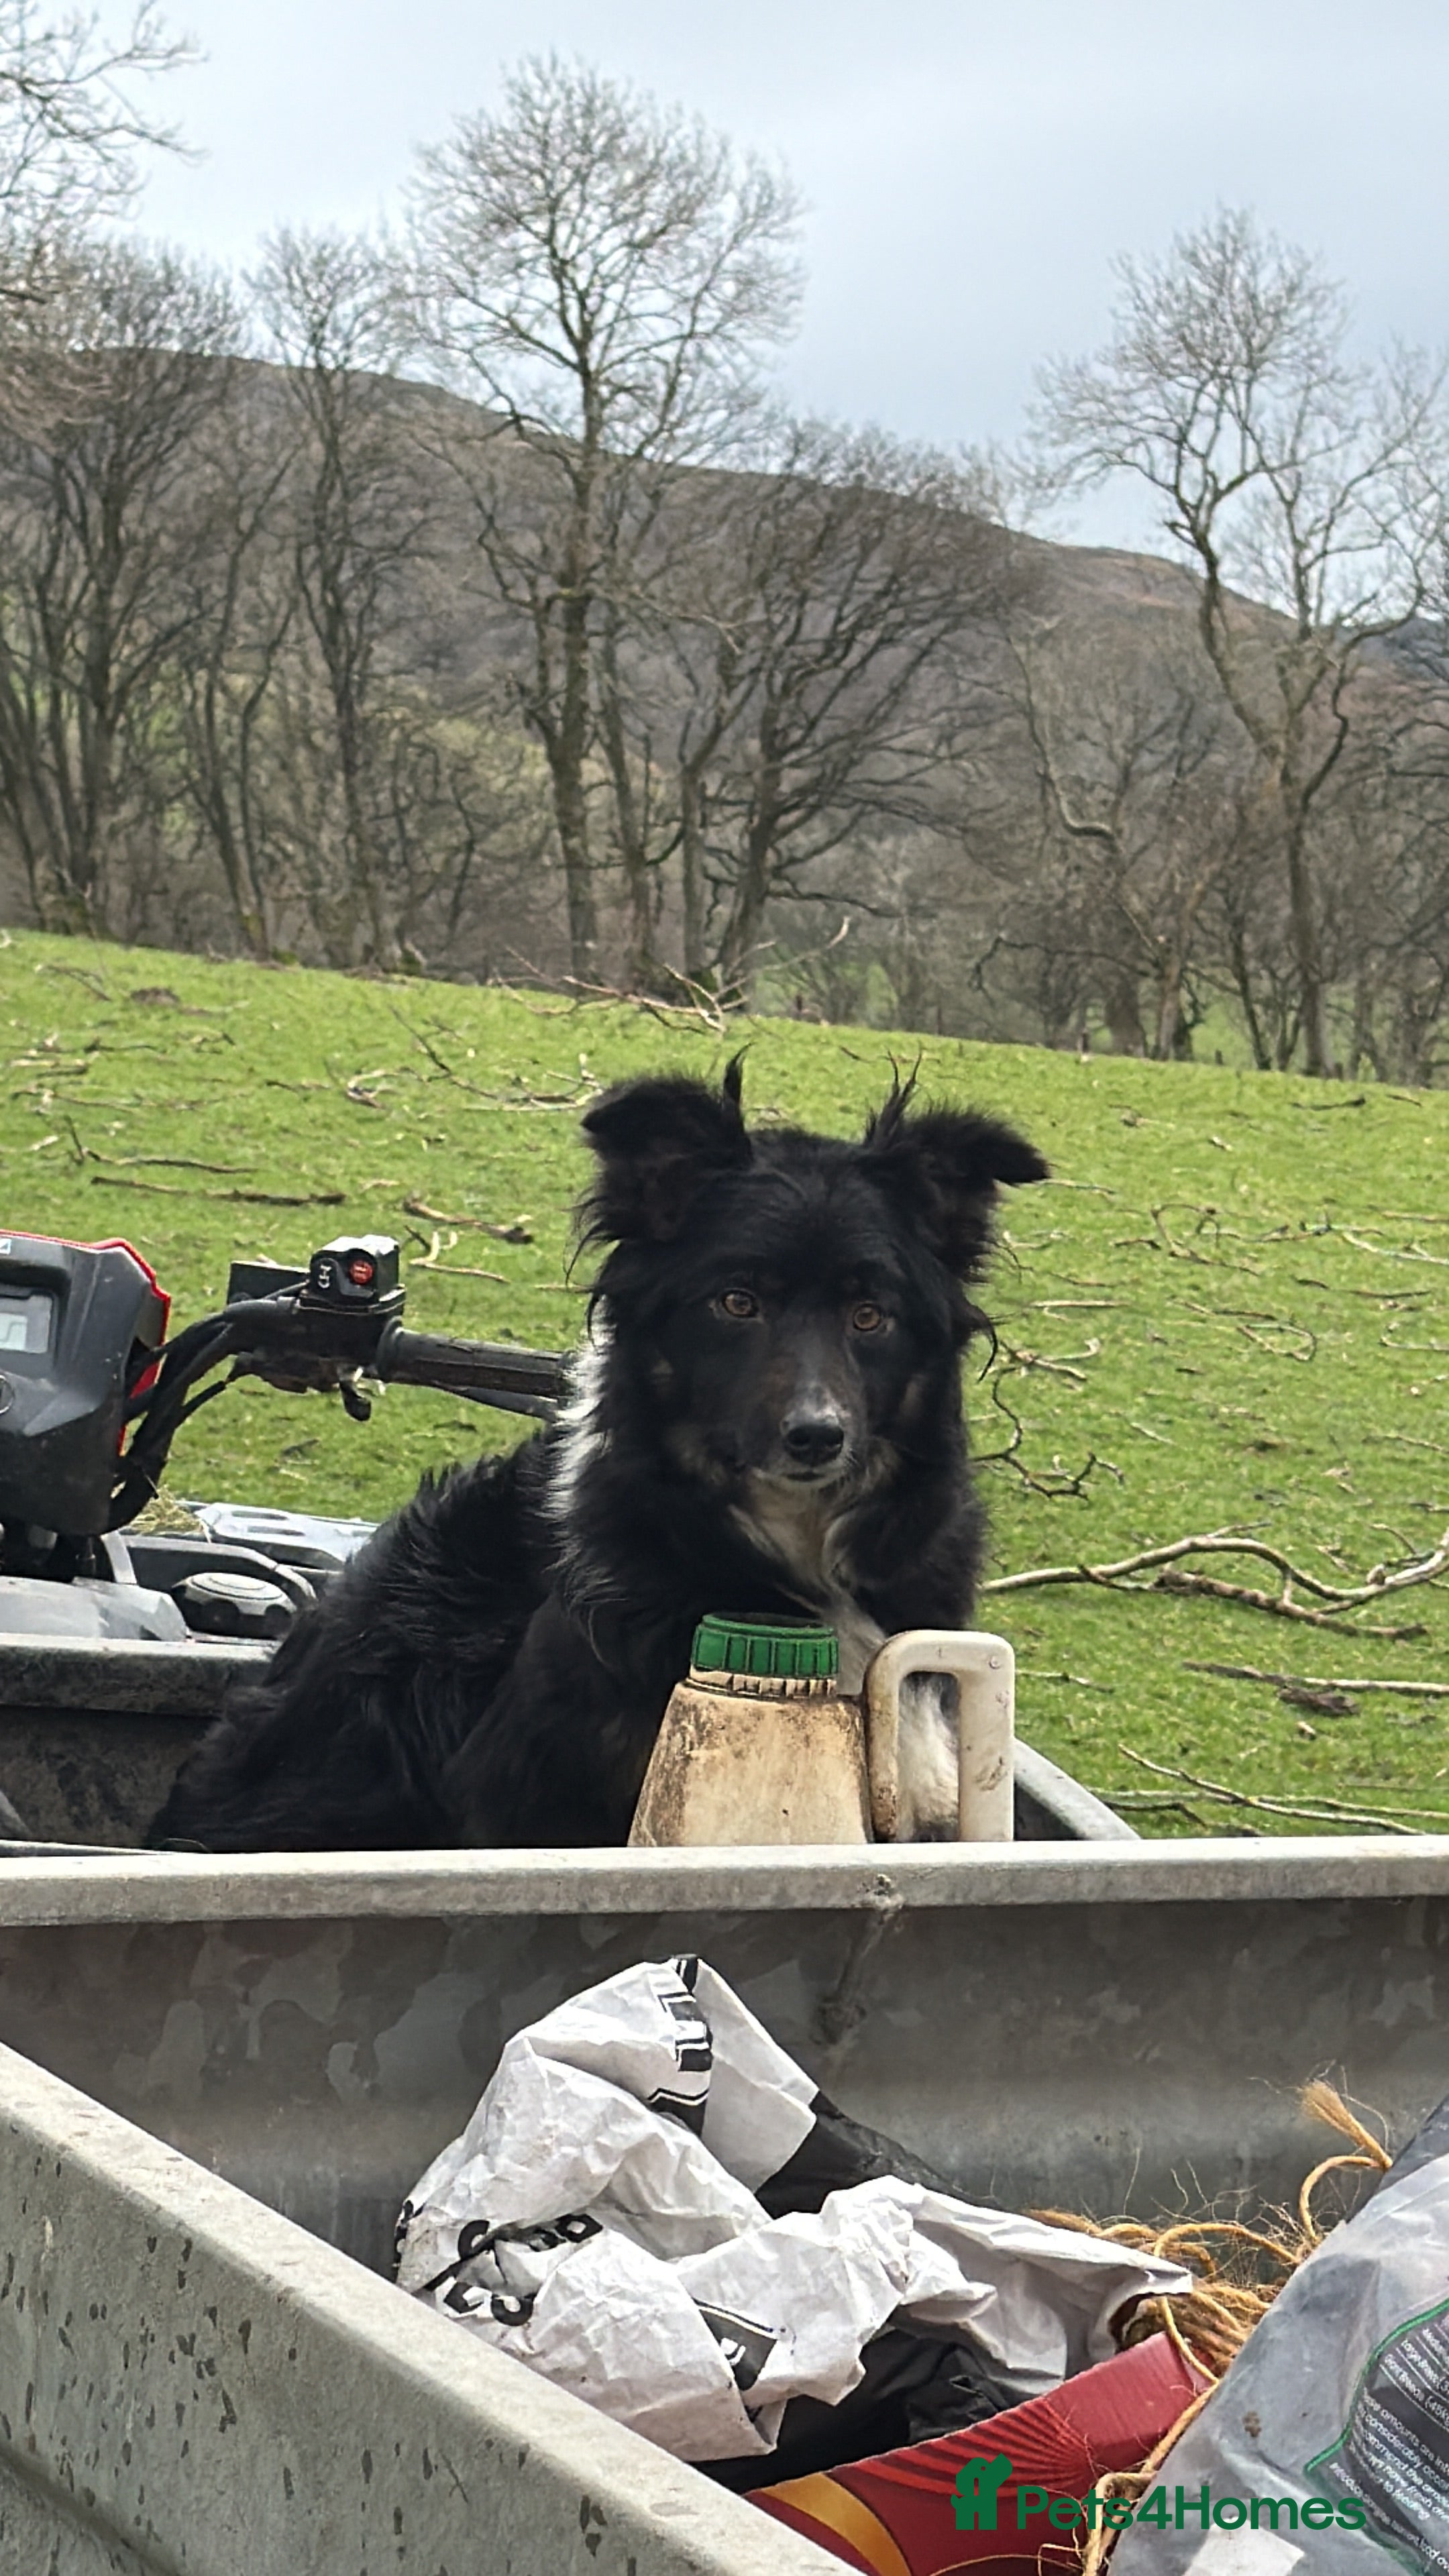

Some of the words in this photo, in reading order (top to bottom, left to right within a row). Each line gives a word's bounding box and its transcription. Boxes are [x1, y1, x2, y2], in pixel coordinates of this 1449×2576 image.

[1365, 2414, 1423, 2469] considerably
[1381, 2409, 1420, 2447] amounts
[1420, 2444, 1434, 2461] are
